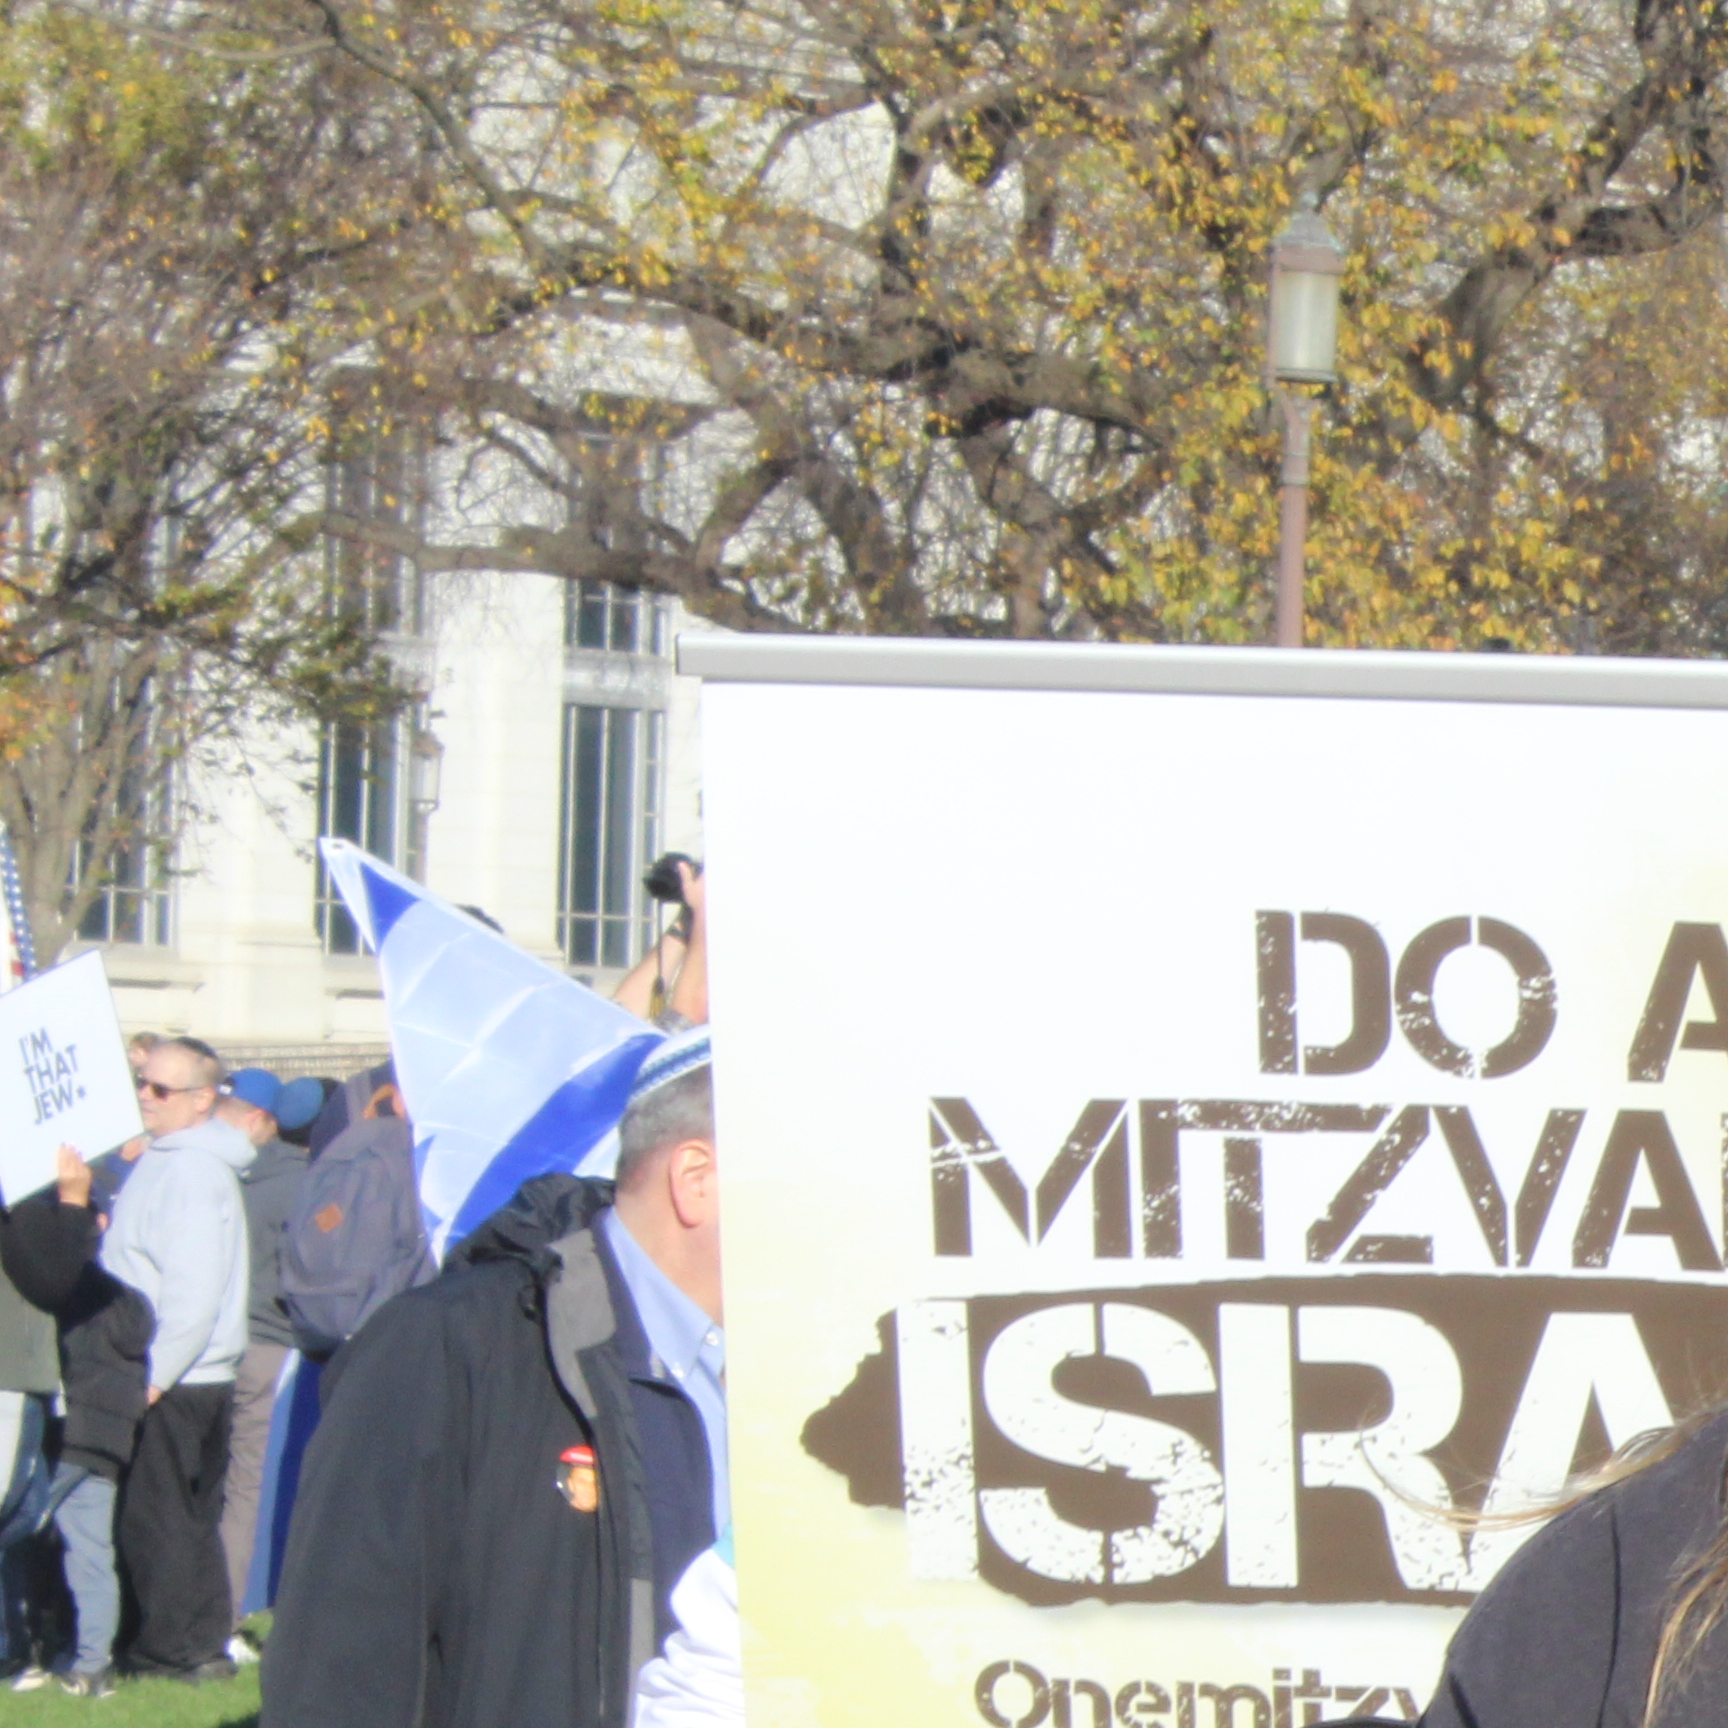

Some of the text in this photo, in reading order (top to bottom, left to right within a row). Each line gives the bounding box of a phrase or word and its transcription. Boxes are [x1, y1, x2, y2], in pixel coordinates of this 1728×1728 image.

[1254, 906, 1558, 1081] DO
[18, 1026, 54, 1067] I'M
[24, 1043, 79, 1096] THAT
